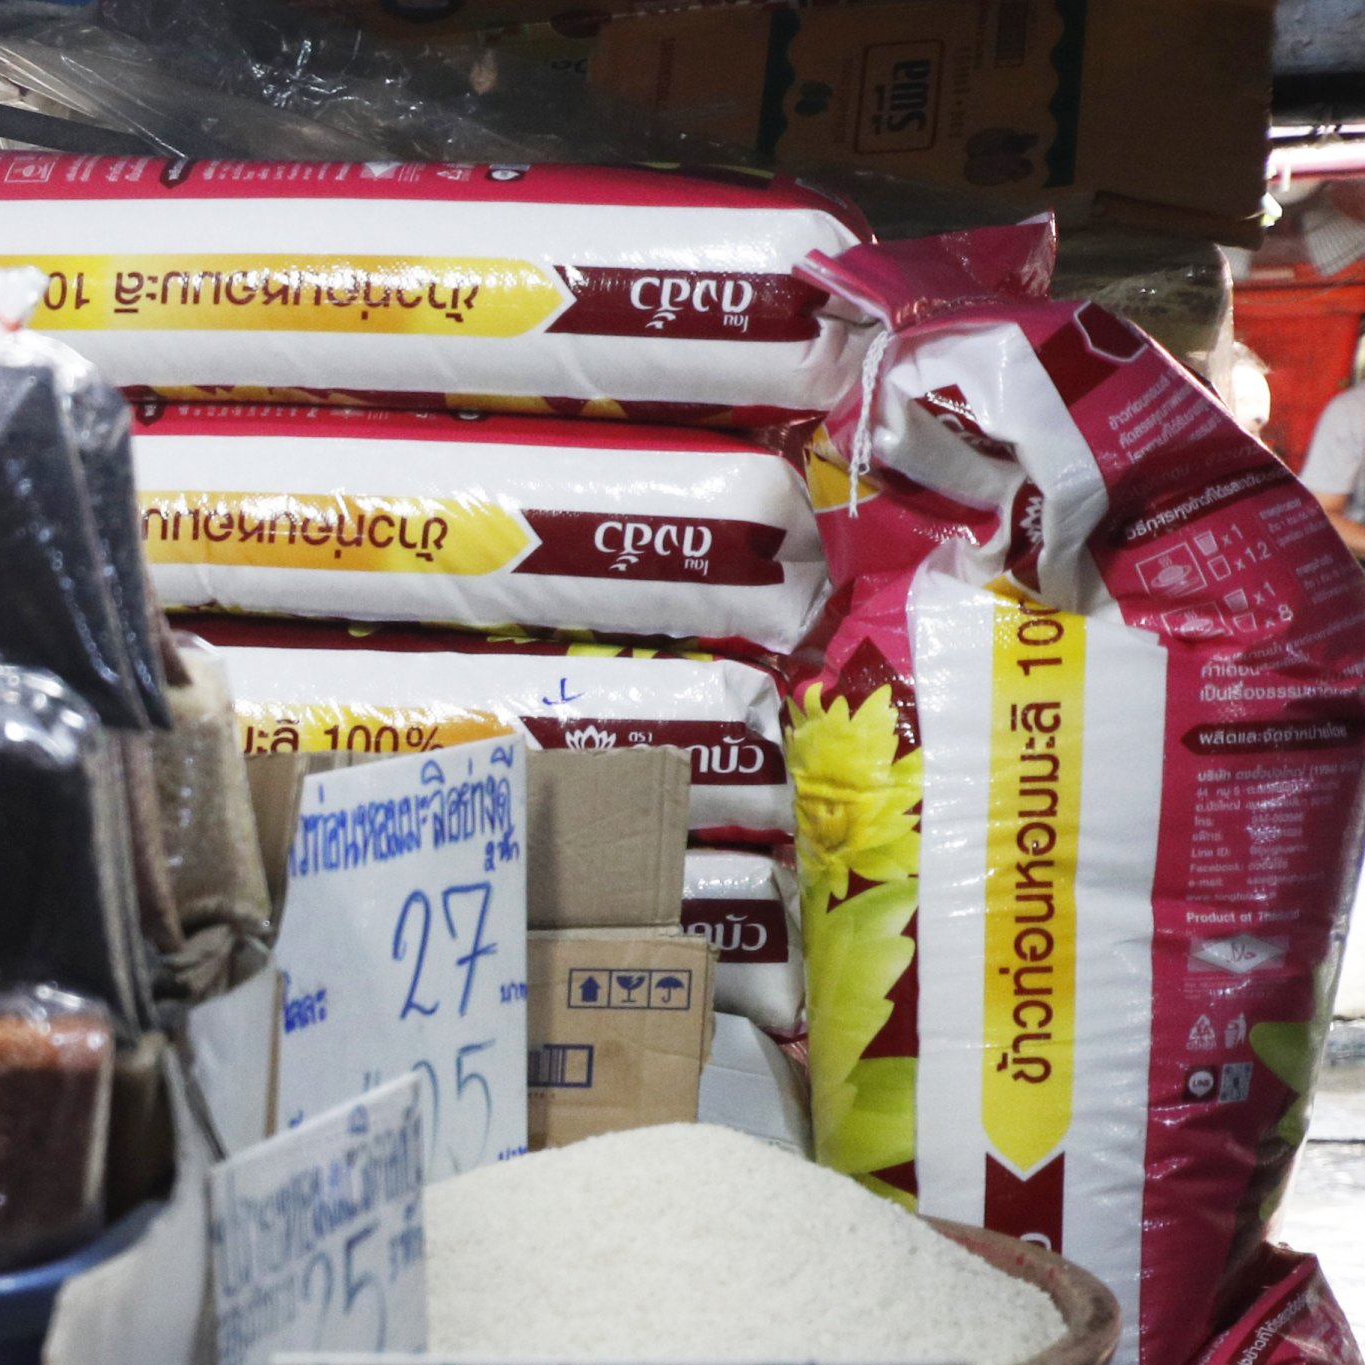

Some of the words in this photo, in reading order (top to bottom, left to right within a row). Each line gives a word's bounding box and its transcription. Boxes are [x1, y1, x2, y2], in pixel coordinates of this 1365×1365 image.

[113, 267, 481, 327] ข้าวท่อนหอมมะลิ
[1277, 604, 1294, 622] 8
[627, 729, 656, 744] ตรา
[995, 700, 1064, 1086] ข้าวท่อนหอมมะลิ
[1185, 911, 1236, 924] Product
[390, 880, 499, 1020] 27
